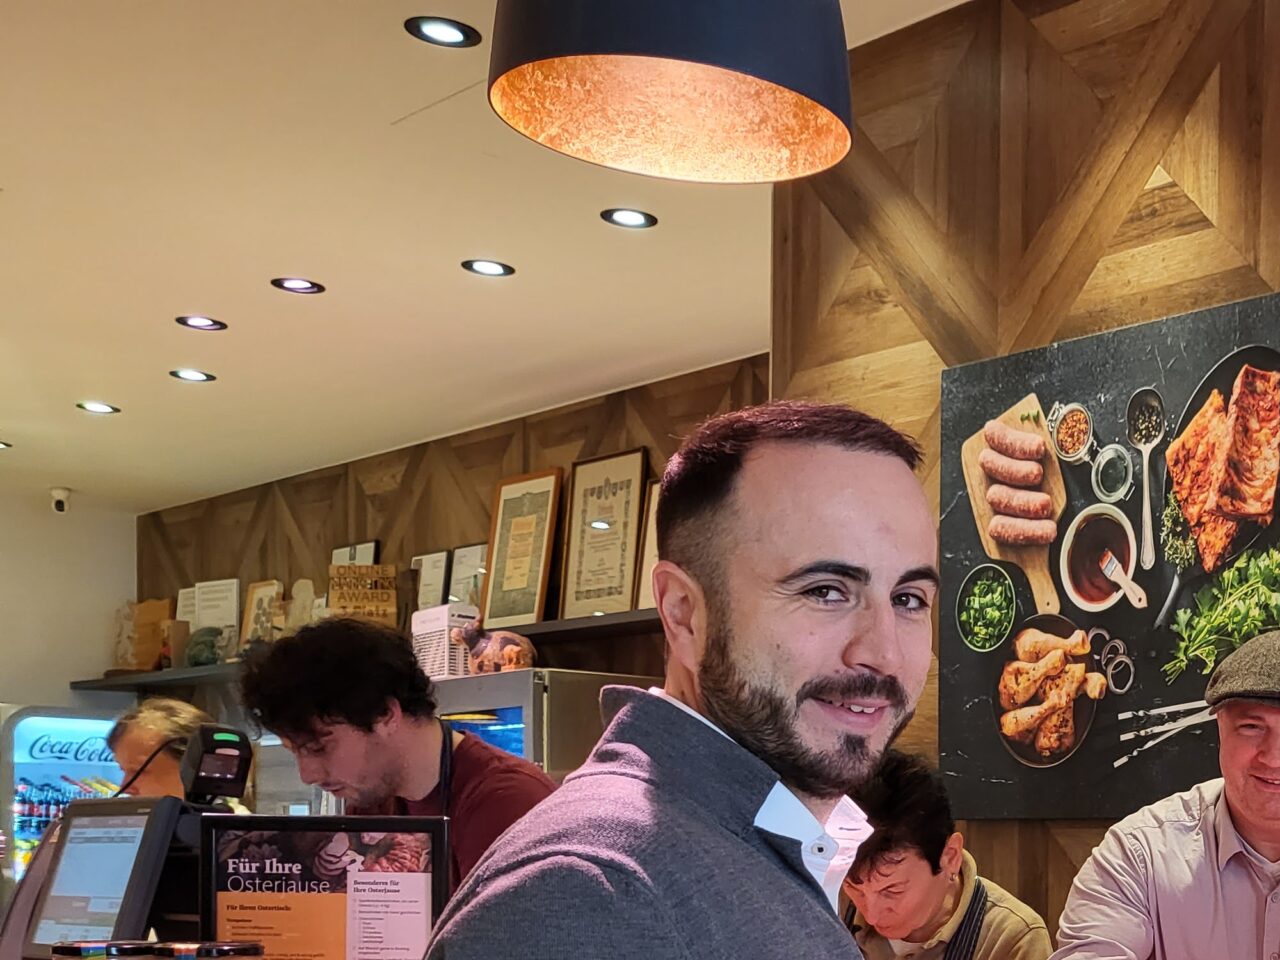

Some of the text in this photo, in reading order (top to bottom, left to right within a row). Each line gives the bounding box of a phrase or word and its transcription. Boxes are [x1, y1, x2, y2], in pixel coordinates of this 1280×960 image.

[336, 565, 389, 577] ONLINE
[337, 591, 390, 603] AWARD
[29, 734, 114, 763] Coca-Cola
[227, 858, 302, 874] Für Ihre
[227, 875, 331, 898] Osterjause
